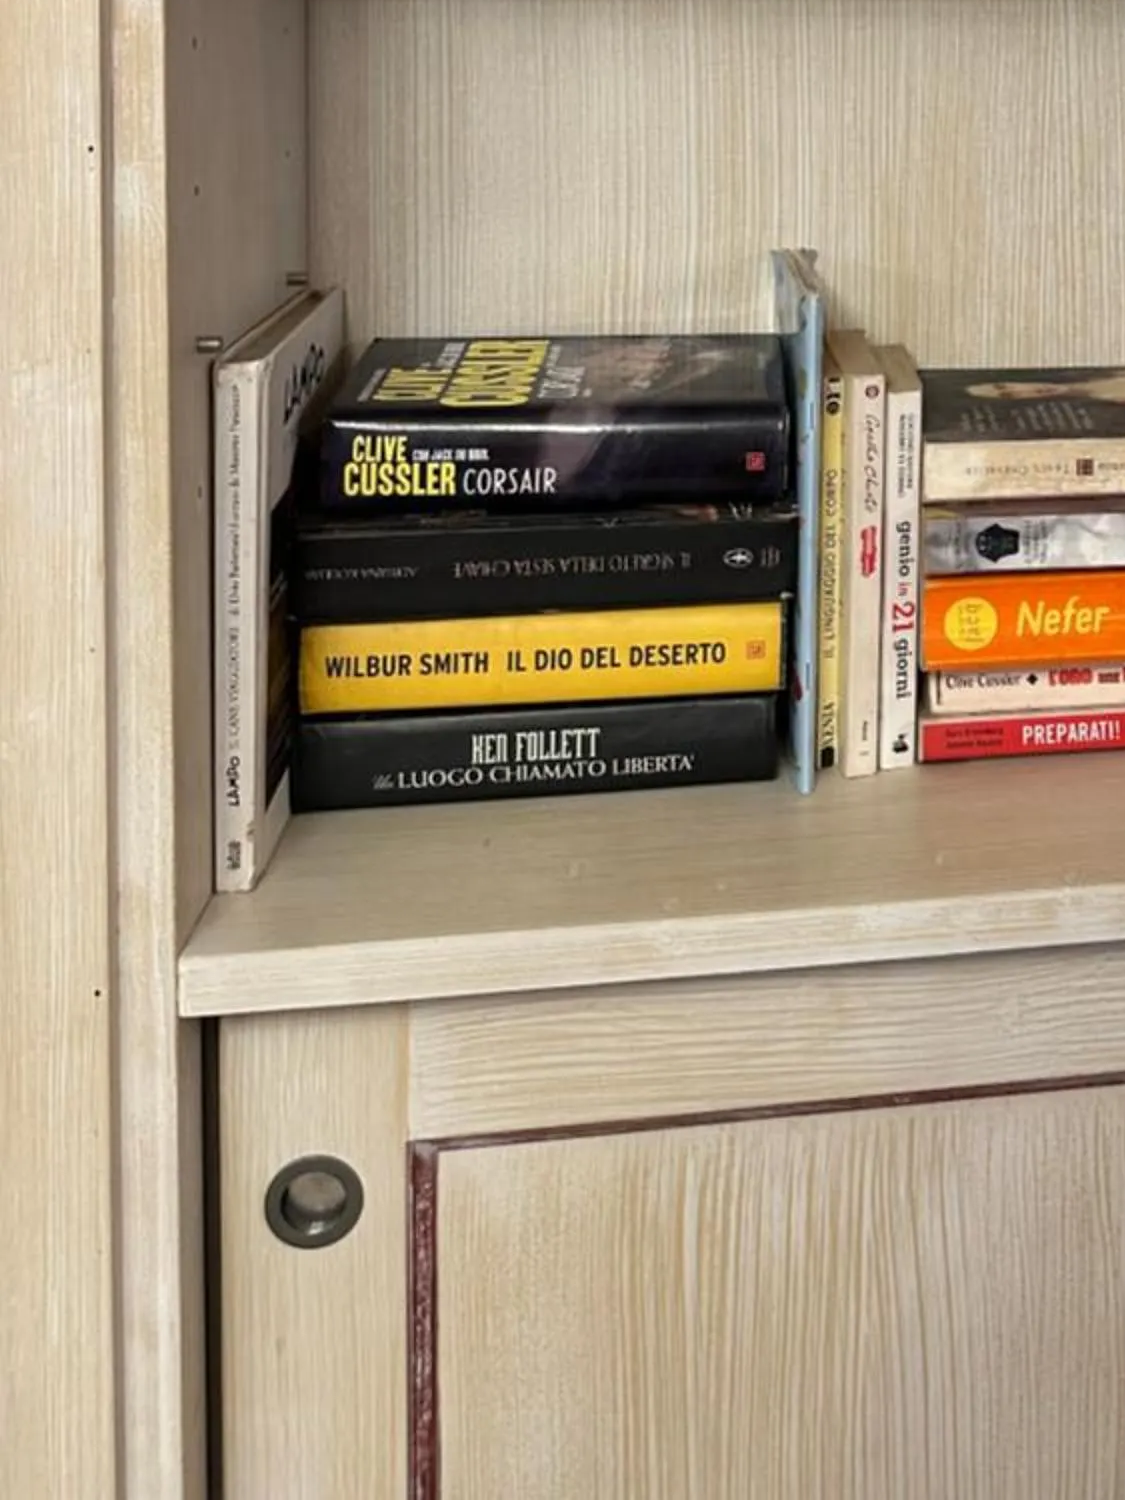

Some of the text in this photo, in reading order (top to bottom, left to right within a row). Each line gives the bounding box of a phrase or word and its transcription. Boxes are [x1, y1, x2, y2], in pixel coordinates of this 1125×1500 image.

[352, 435, 408, 462] CLIVE
[343, 462, 557, 496] CUSSLER CORSAIR
[826, 468, 838, 517] CORPO
[825, 524, 837, 549] DEL
[896, 521, 915, 577] genio
[823, 553, 837, 639] LINGUAGGIO
[898, 582, 912, 597] in
[892, 602, 914, 632] 21
[1016, 595, 1110, 637] Nefer
[325, 642, 726, 678] WILBUR SMITH IL DIO DEL DESERTO
[894, 638, 912, 699] giorni
[471, 728, 600, 765] KEN FOLLETT
[1021, 720, 1121, 746] PREPARATI!
[226, 755, 241, 806] LAMPO
[398, 767, 484, 790] LUOGO
[489, 760, 607, 783] CHIAMATO
